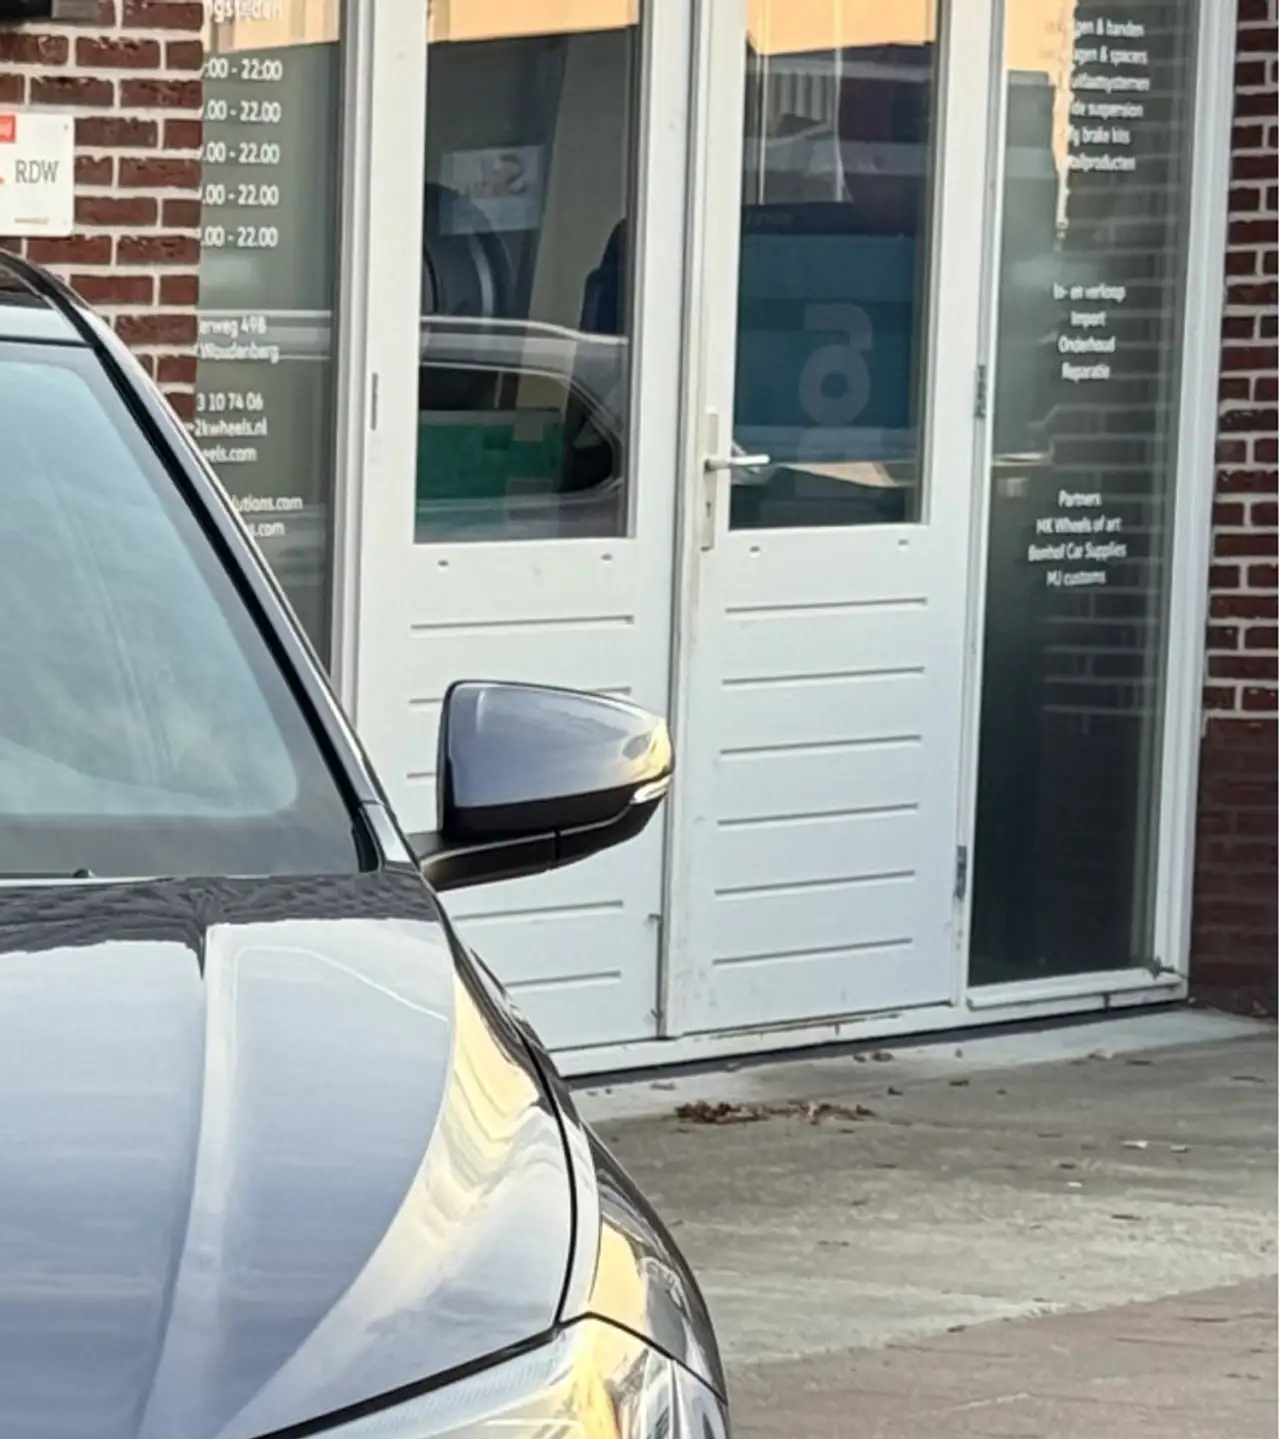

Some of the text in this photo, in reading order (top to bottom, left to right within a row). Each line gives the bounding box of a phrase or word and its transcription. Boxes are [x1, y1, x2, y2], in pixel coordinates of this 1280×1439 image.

[203, 99, 228, 120] .00
[240, 100, 281, 123] 22.00
[202, 141, 226, 163] .00
[238, 142, 280, 164] 22.00
[15, 159, 60, 184] RDW
[202, 184, 226, 205] .00
[237, 184, 279, 206] 22.00
[200, 226, 225, 248] .00
[236, 226, 278, 248] 22.00
[1070, 310, 1107, 331] Import
[1058, 335, 1116, 353] Onderhoud
[1061, 361, 1110, 384] Reparatie
[209, 393, 225, 411] 10
[246, 391, 264, 411] 06
[1058, 489, 1102, 507] Partners
